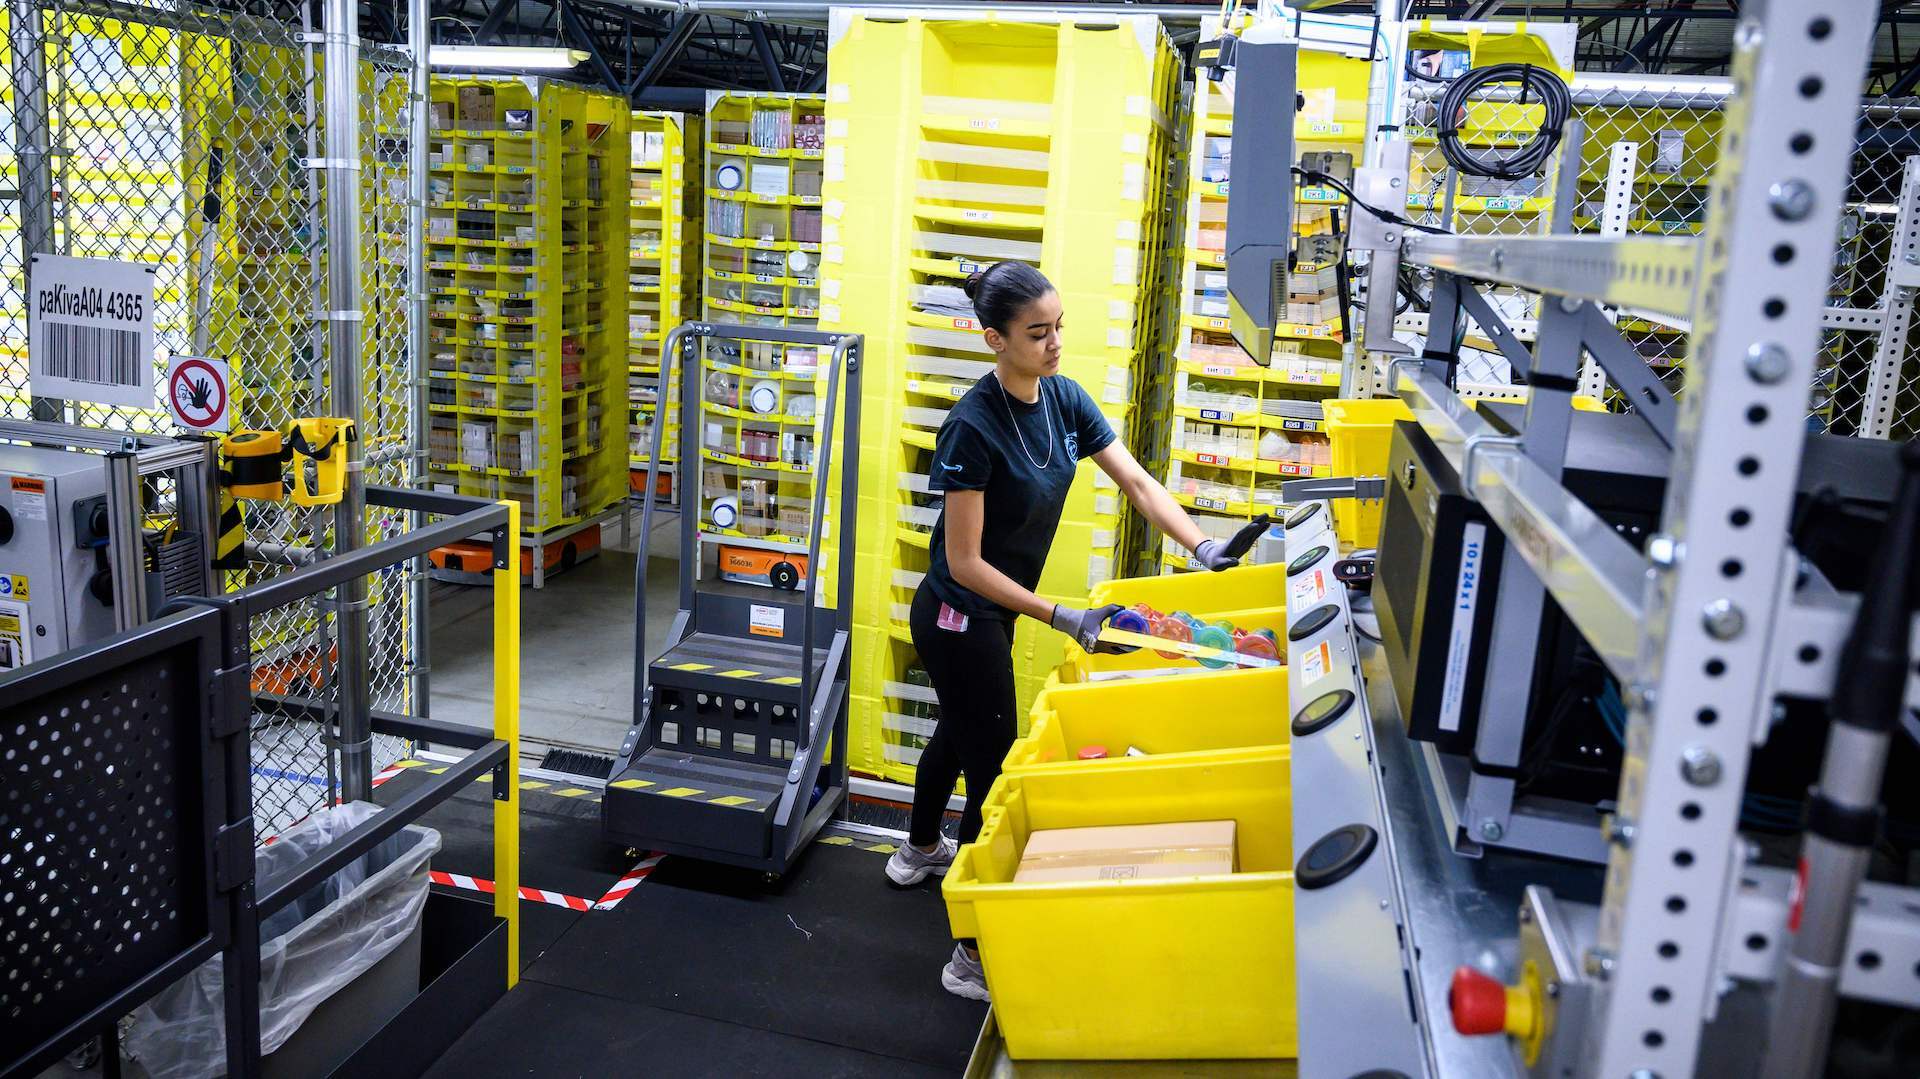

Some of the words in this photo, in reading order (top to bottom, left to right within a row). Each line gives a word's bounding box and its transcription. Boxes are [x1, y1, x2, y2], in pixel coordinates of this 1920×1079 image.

[39, 283, 103, 320] paKivaA04
[106, 291, 143, 322] 4365
[1466, 542, 1478, 559] 10
[1463, 573, 1475, 589] 24
